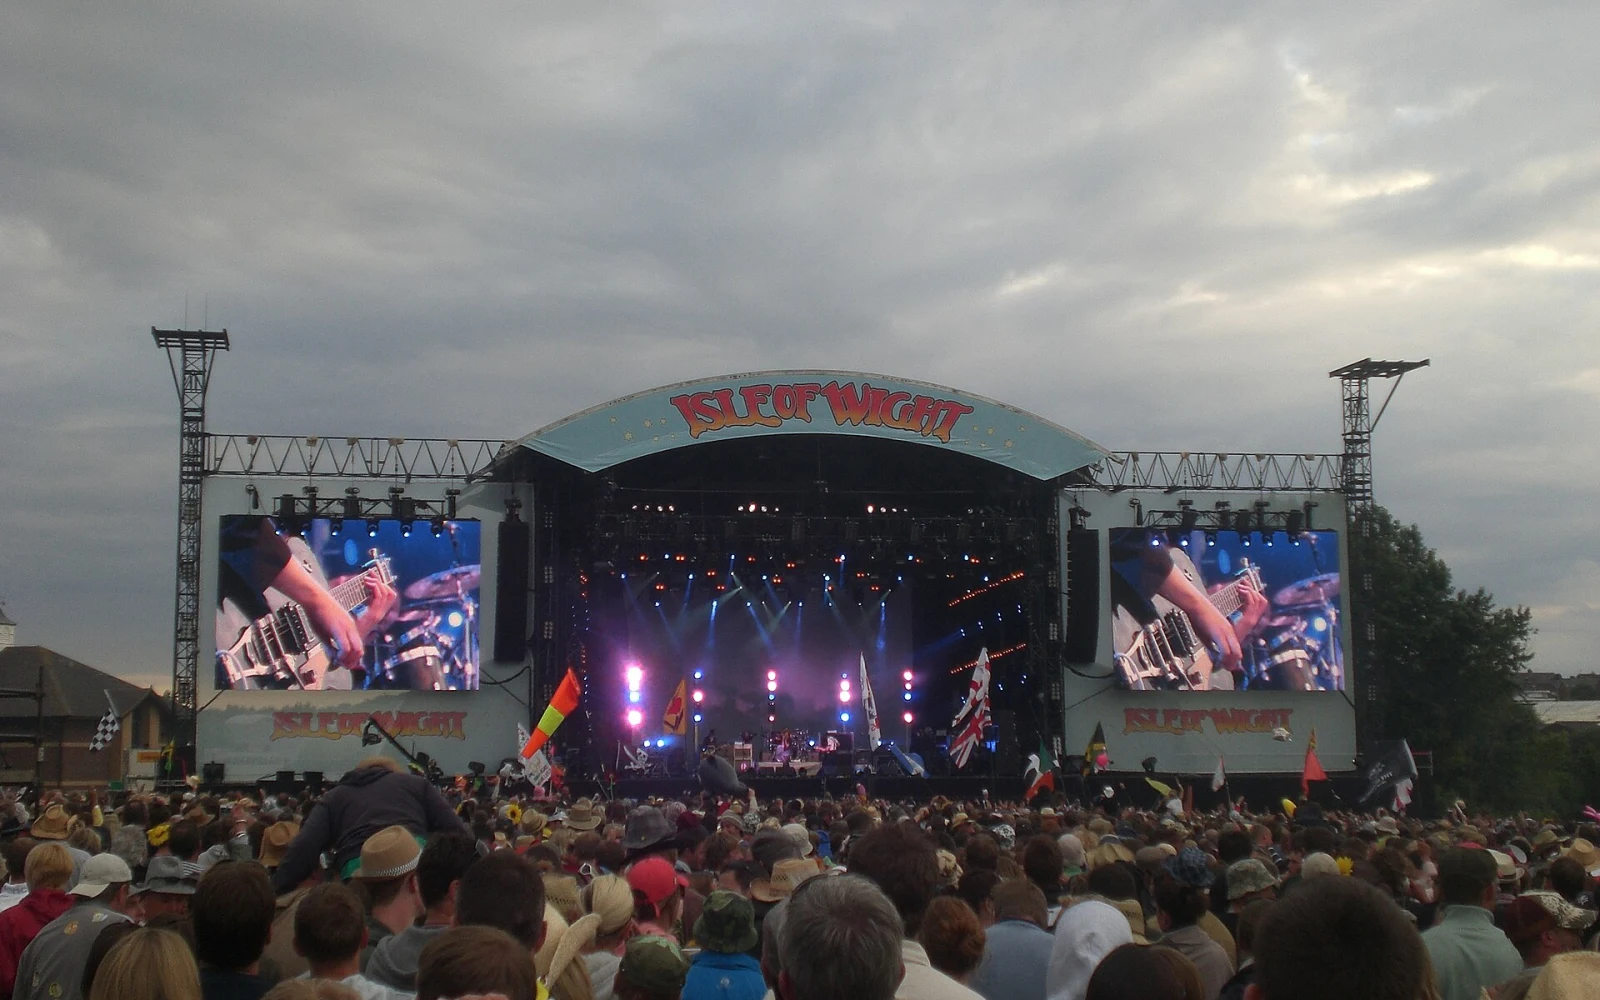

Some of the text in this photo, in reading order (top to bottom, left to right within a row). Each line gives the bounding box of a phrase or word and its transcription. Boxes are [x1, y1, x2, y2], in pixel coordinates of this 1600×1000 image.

[670, 380, 974, 444] ISLE OF WIGHT
[270, 712, 341, 742] ISLE
[337, 712, 371, 737] OF
[1123, 708, 1293, 735] ISLE OF WIGHT
